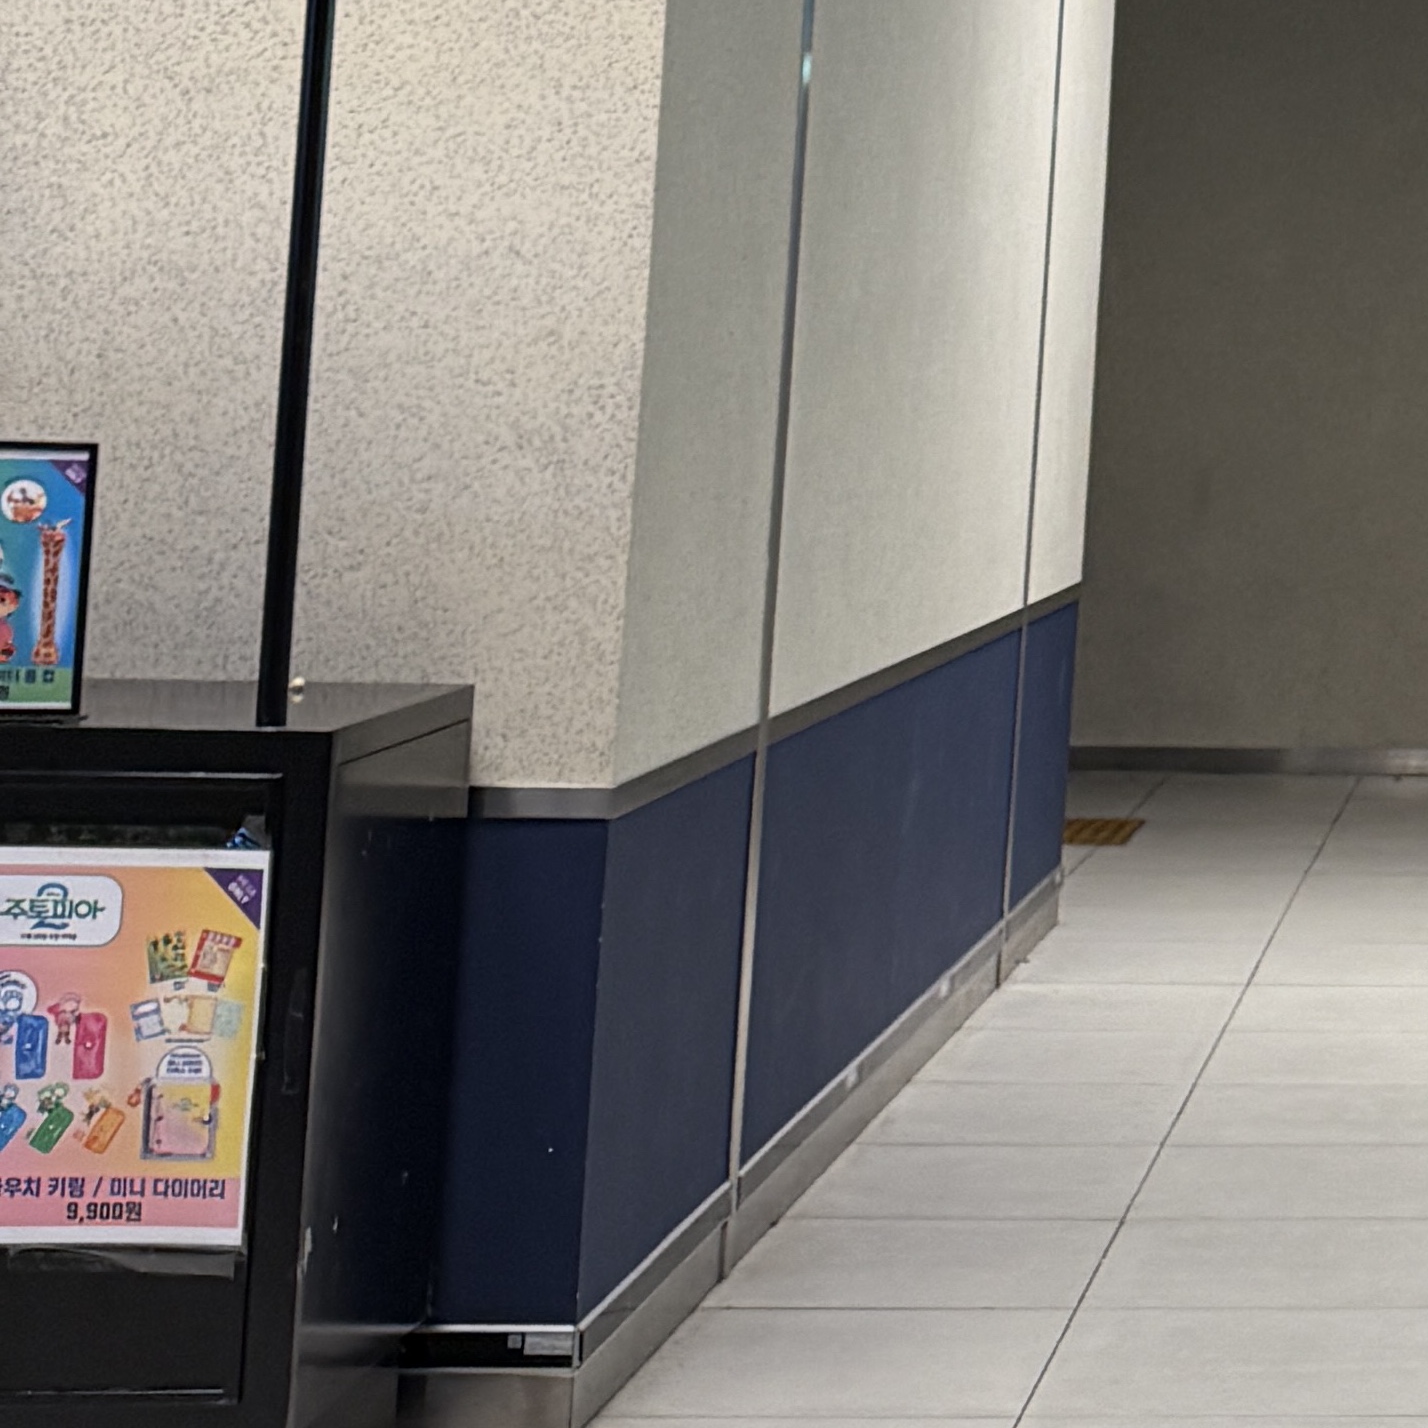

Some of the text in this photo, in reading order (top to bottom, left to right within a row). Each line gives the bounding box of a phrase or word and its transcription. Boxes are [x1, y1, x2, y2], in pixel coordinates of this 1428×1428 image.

[0, 898, 106, 920] 주토피아
[0, 1176, 41, 1198] 우치
[109, 1177, 146, 1199] 미니
[66, 1201, 142, 1223] 9,900원
